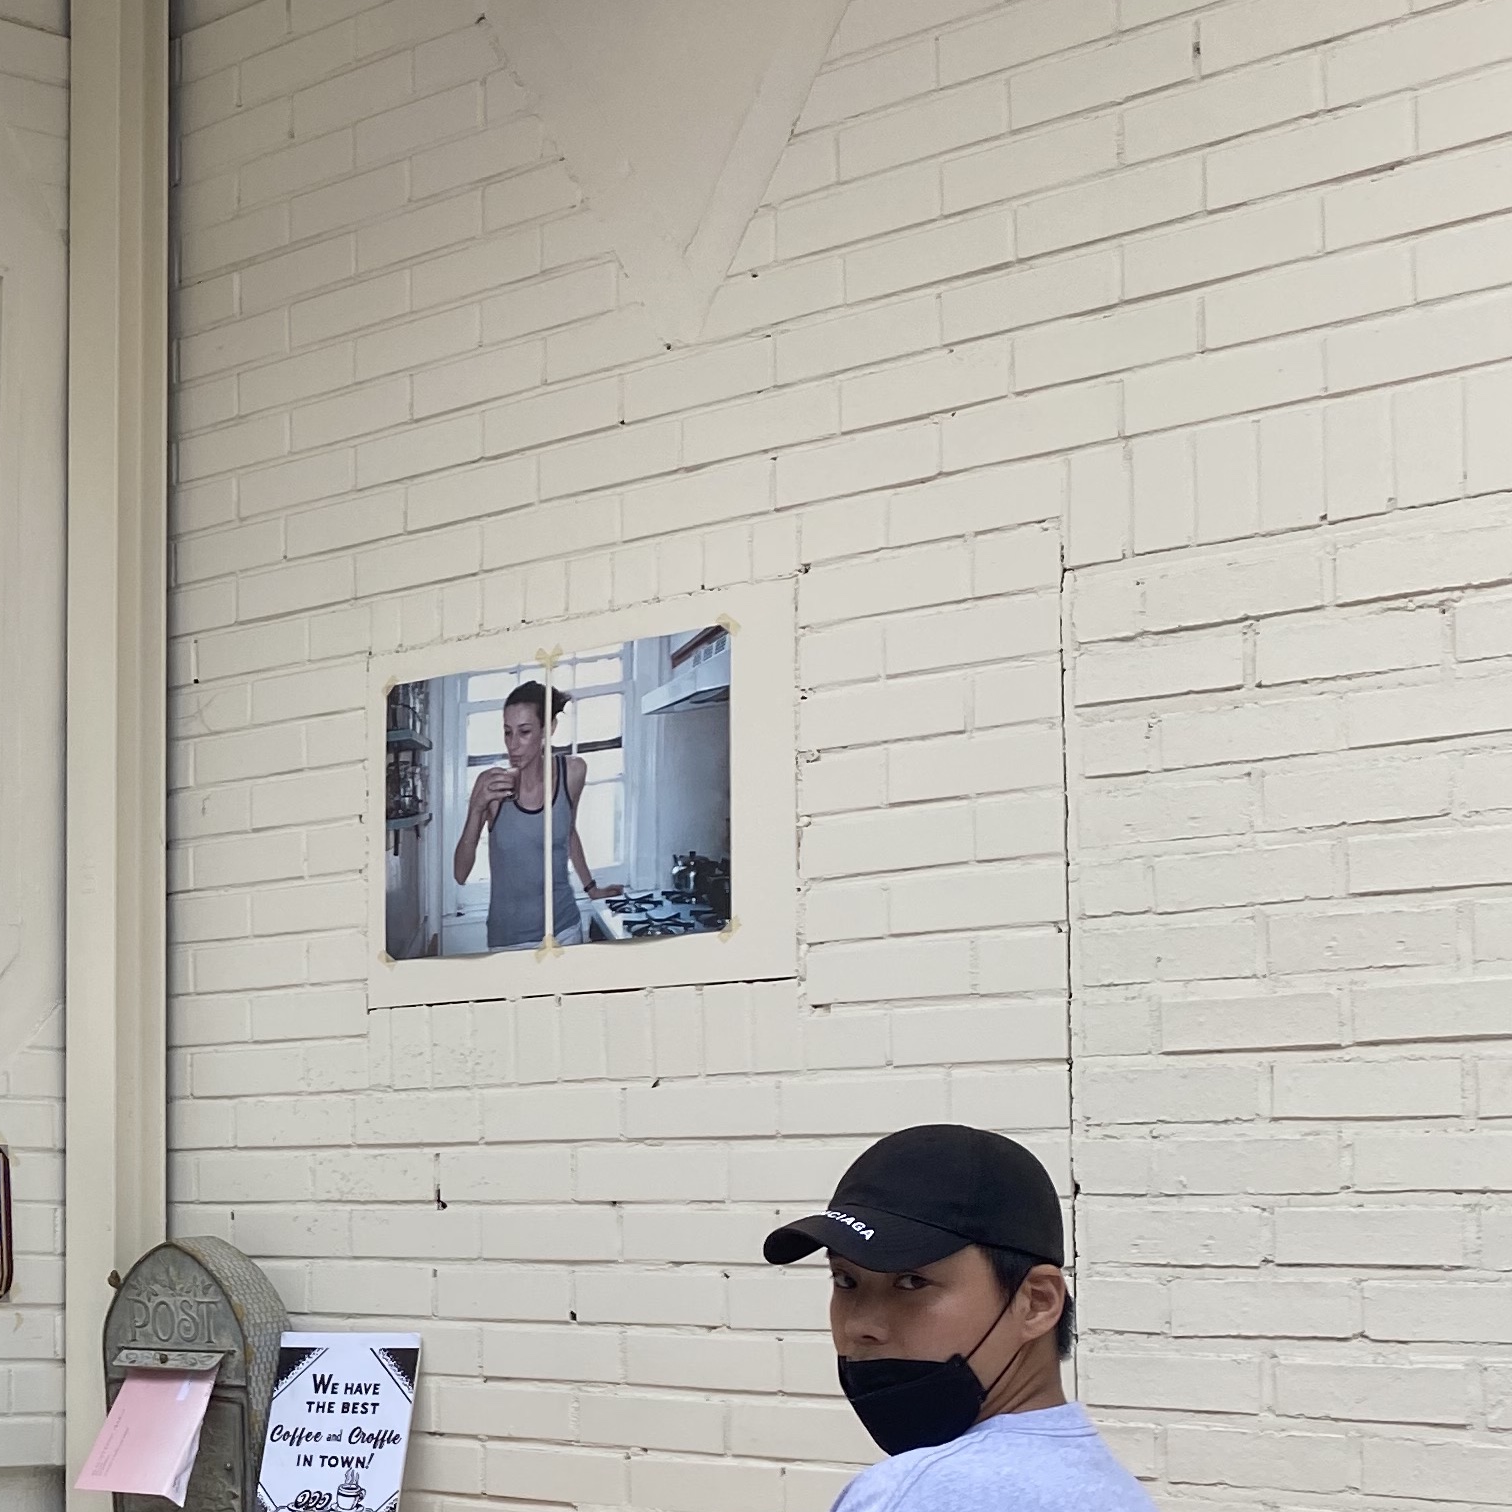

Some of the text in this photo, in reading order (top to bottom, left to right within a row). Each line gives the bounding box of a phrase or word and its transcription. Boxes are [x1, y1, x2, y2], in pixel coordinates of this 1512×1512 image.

[126, 1297, 221, 1344] POST
[343, 1382, 381, 1396] HAVE
[306, 1401, 380, 1415] THE BEST
[269, 1424, 402, 1450] Coffee and Croffle
[296, 1452, 375, 1470] IN TOWN!
